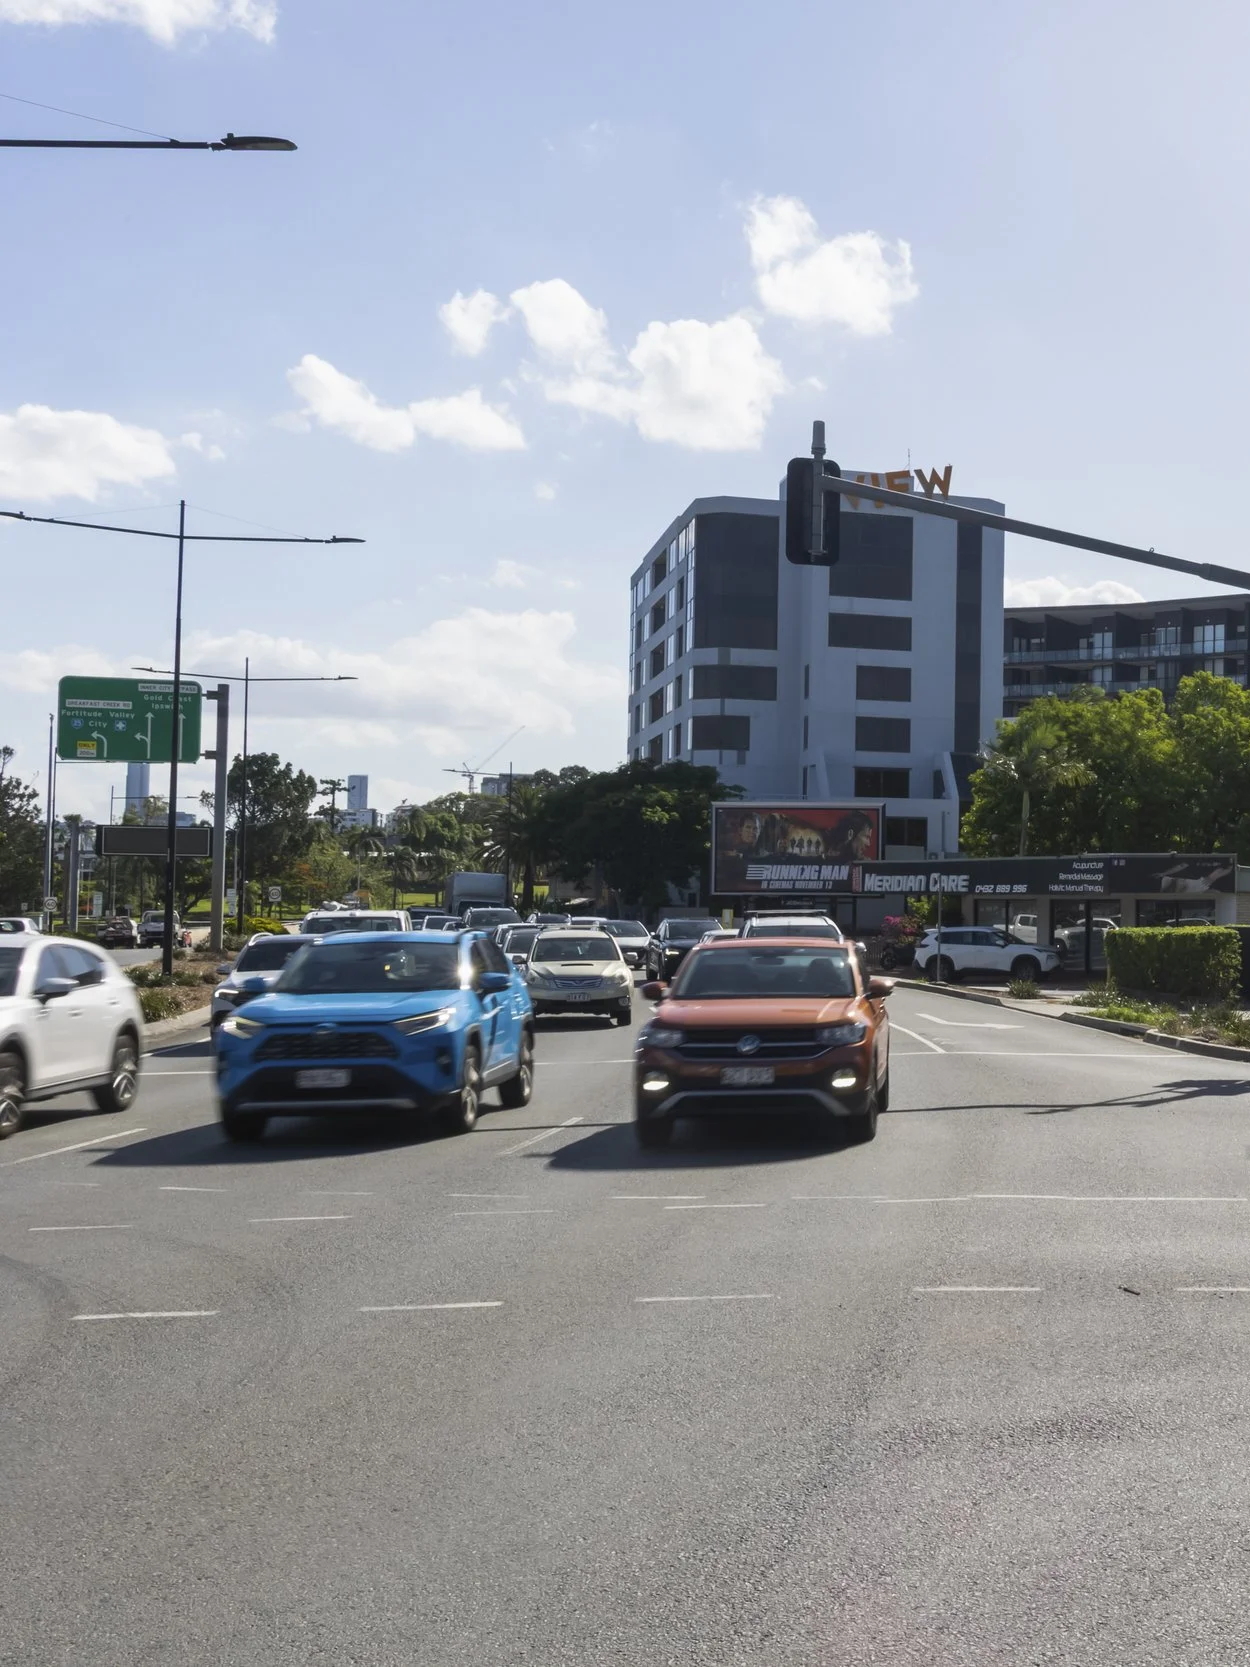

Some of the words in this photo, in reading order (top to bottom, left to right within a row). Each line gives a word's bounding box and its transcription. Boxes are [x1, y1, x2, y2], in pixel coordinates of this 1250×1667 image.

[61, 709, 102, 717] Fortitude
[109, 711, 136, 719] Valley
[89, 720, 107, 728] City
[819, 864, 850, 880] MAN
[769, 880, 794, 889] CINEMAS
[794, 880, 824, 889] NOVEMBER
